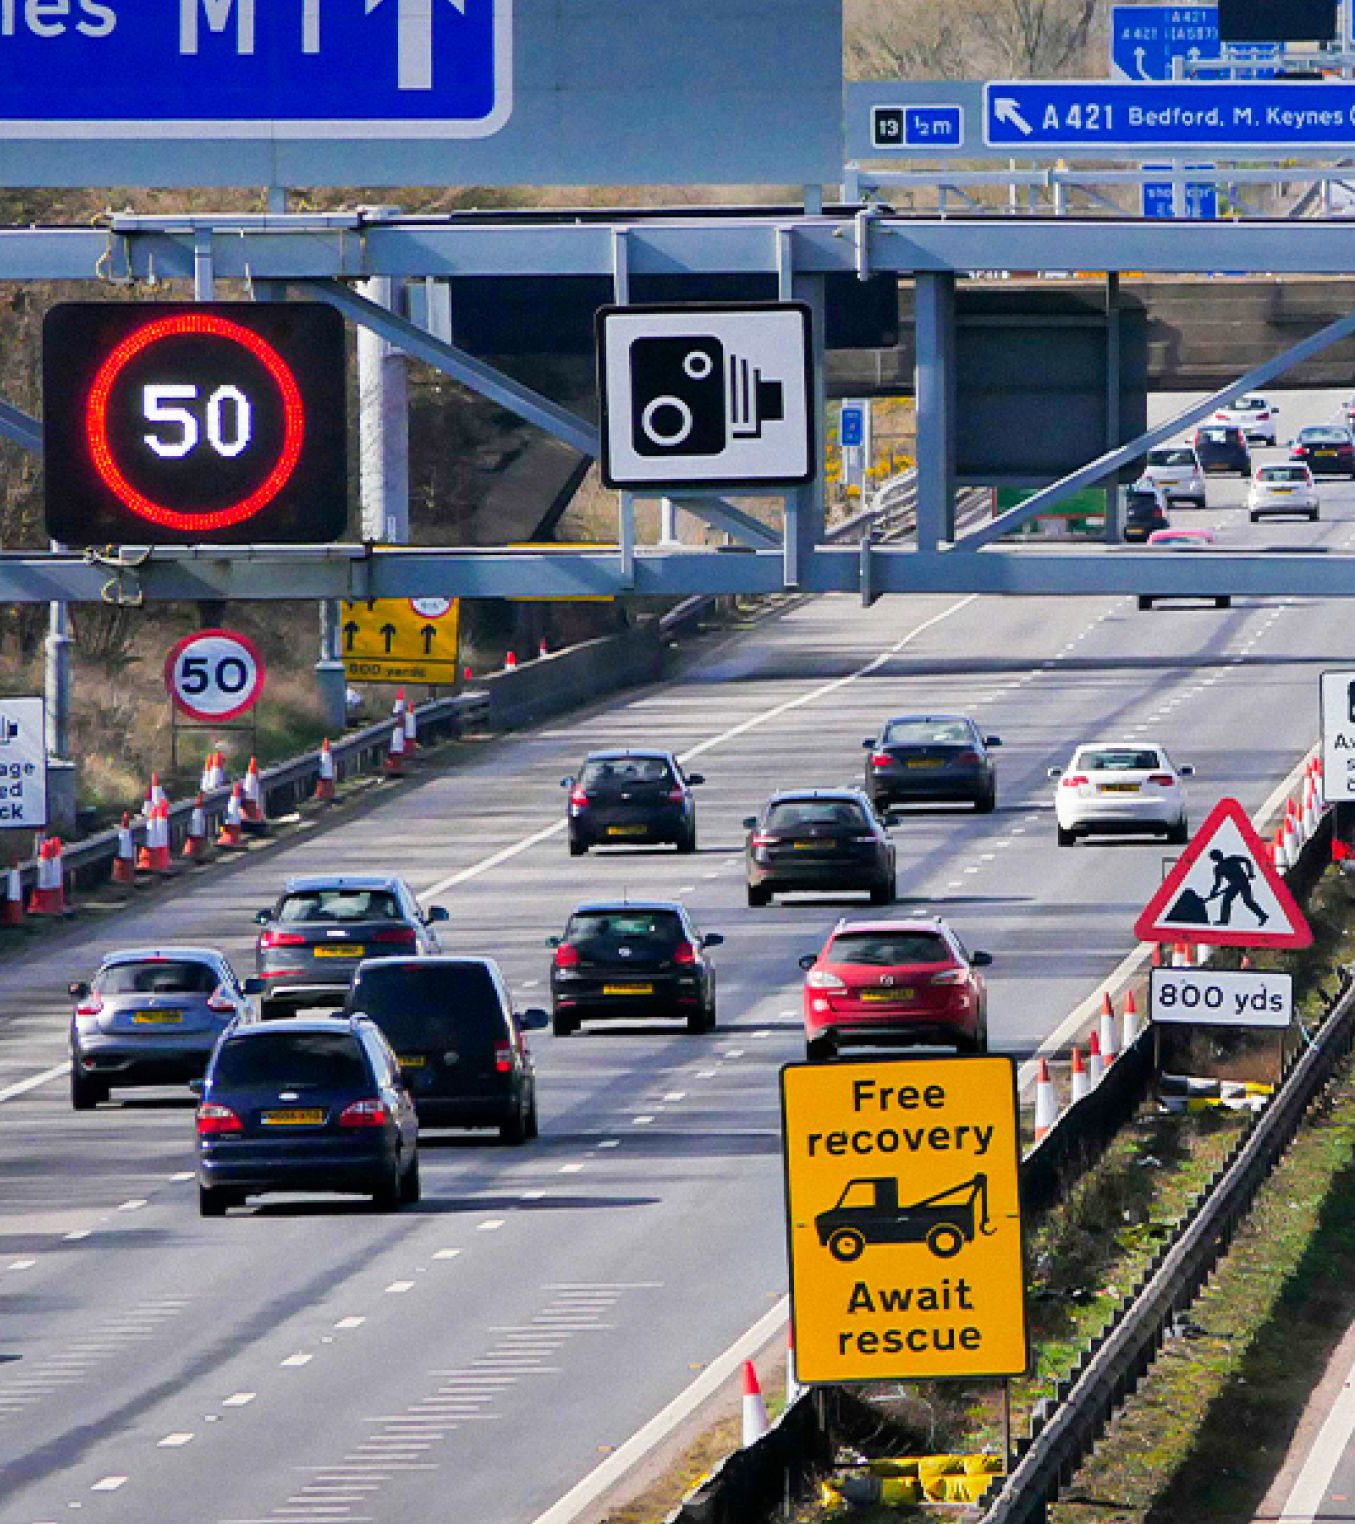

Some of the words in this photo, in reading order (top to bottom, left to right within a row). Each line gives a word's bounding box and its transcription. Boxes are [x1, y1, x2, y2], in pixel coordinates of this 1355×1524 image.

[2, 0, 116, 37] es
[879, 119, 899, 137] 13
[1041, 103, 1113, 130] A421
[1266, 105, 1343, 129] Keynes
[142, 384, 252, 458] 50
[181, 656, 248, 695] 50
[1158, 982, 1224, 1008] 800
[1235, 986, 1283, 1016] yds
[852, 1079, 946, 1112] Free
[807, 1123, 995, 1158] recovery
[846, 1277, 975, 1315] Await
[838, 1325, 983, 1356] rescue
